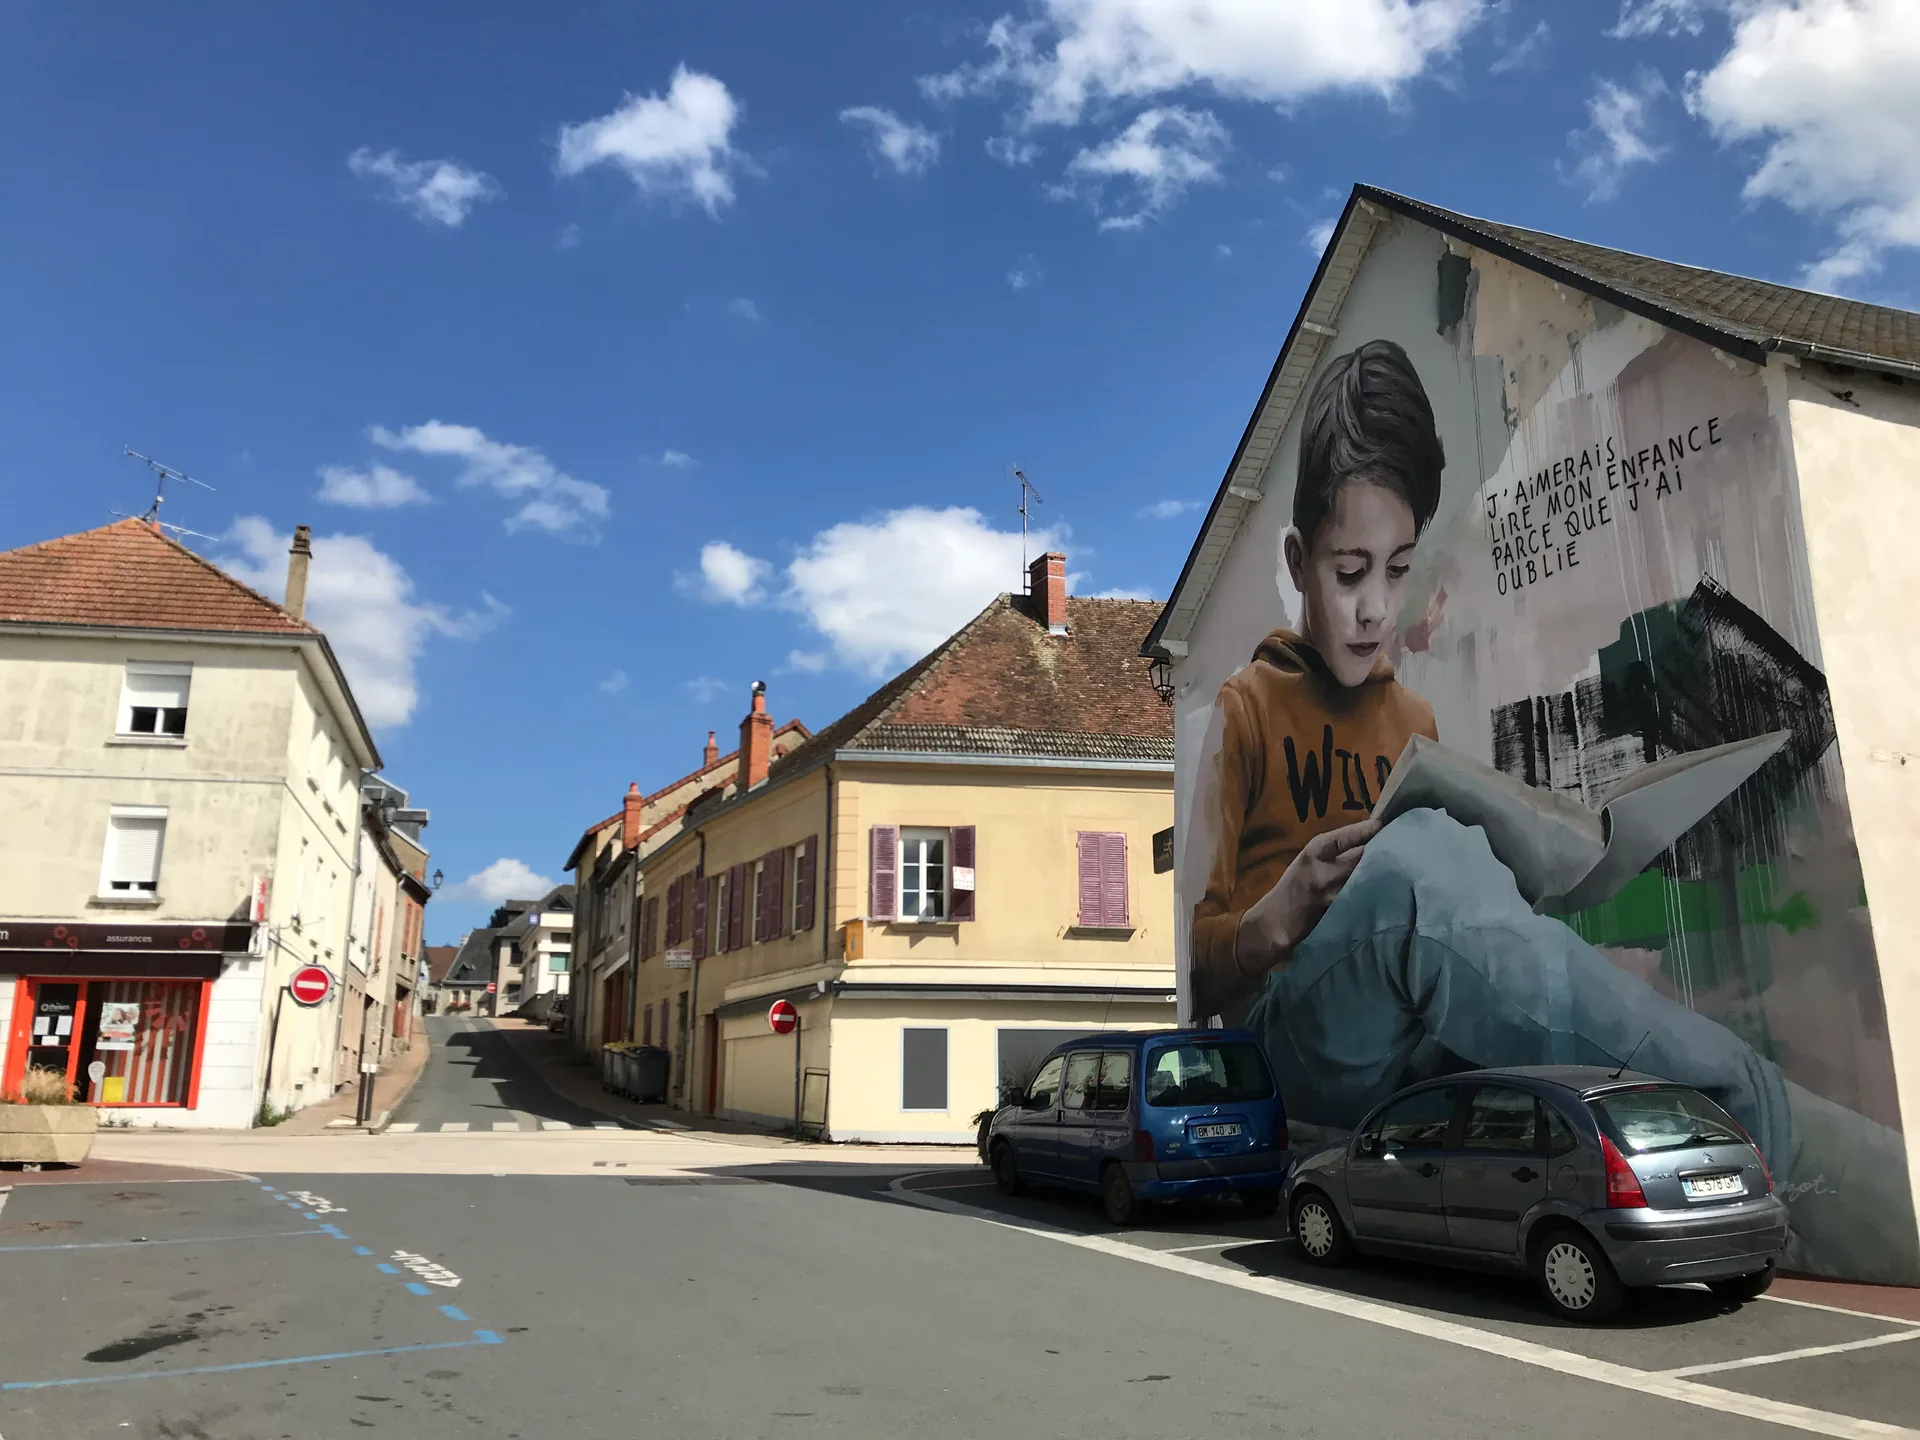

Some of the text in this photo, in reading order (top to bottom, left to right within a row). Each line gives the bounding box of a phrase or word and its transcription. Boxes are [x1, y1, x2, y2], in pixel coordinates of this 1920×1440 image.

[1546, 476, 1593, 519] MON
[1608, 416, 1722, 491] ENFANCE
[1491, 523, 1554, 571] PARCE
[1564, 496, 1612, 538] QUE
[106, 934, 153, 943] assurances
